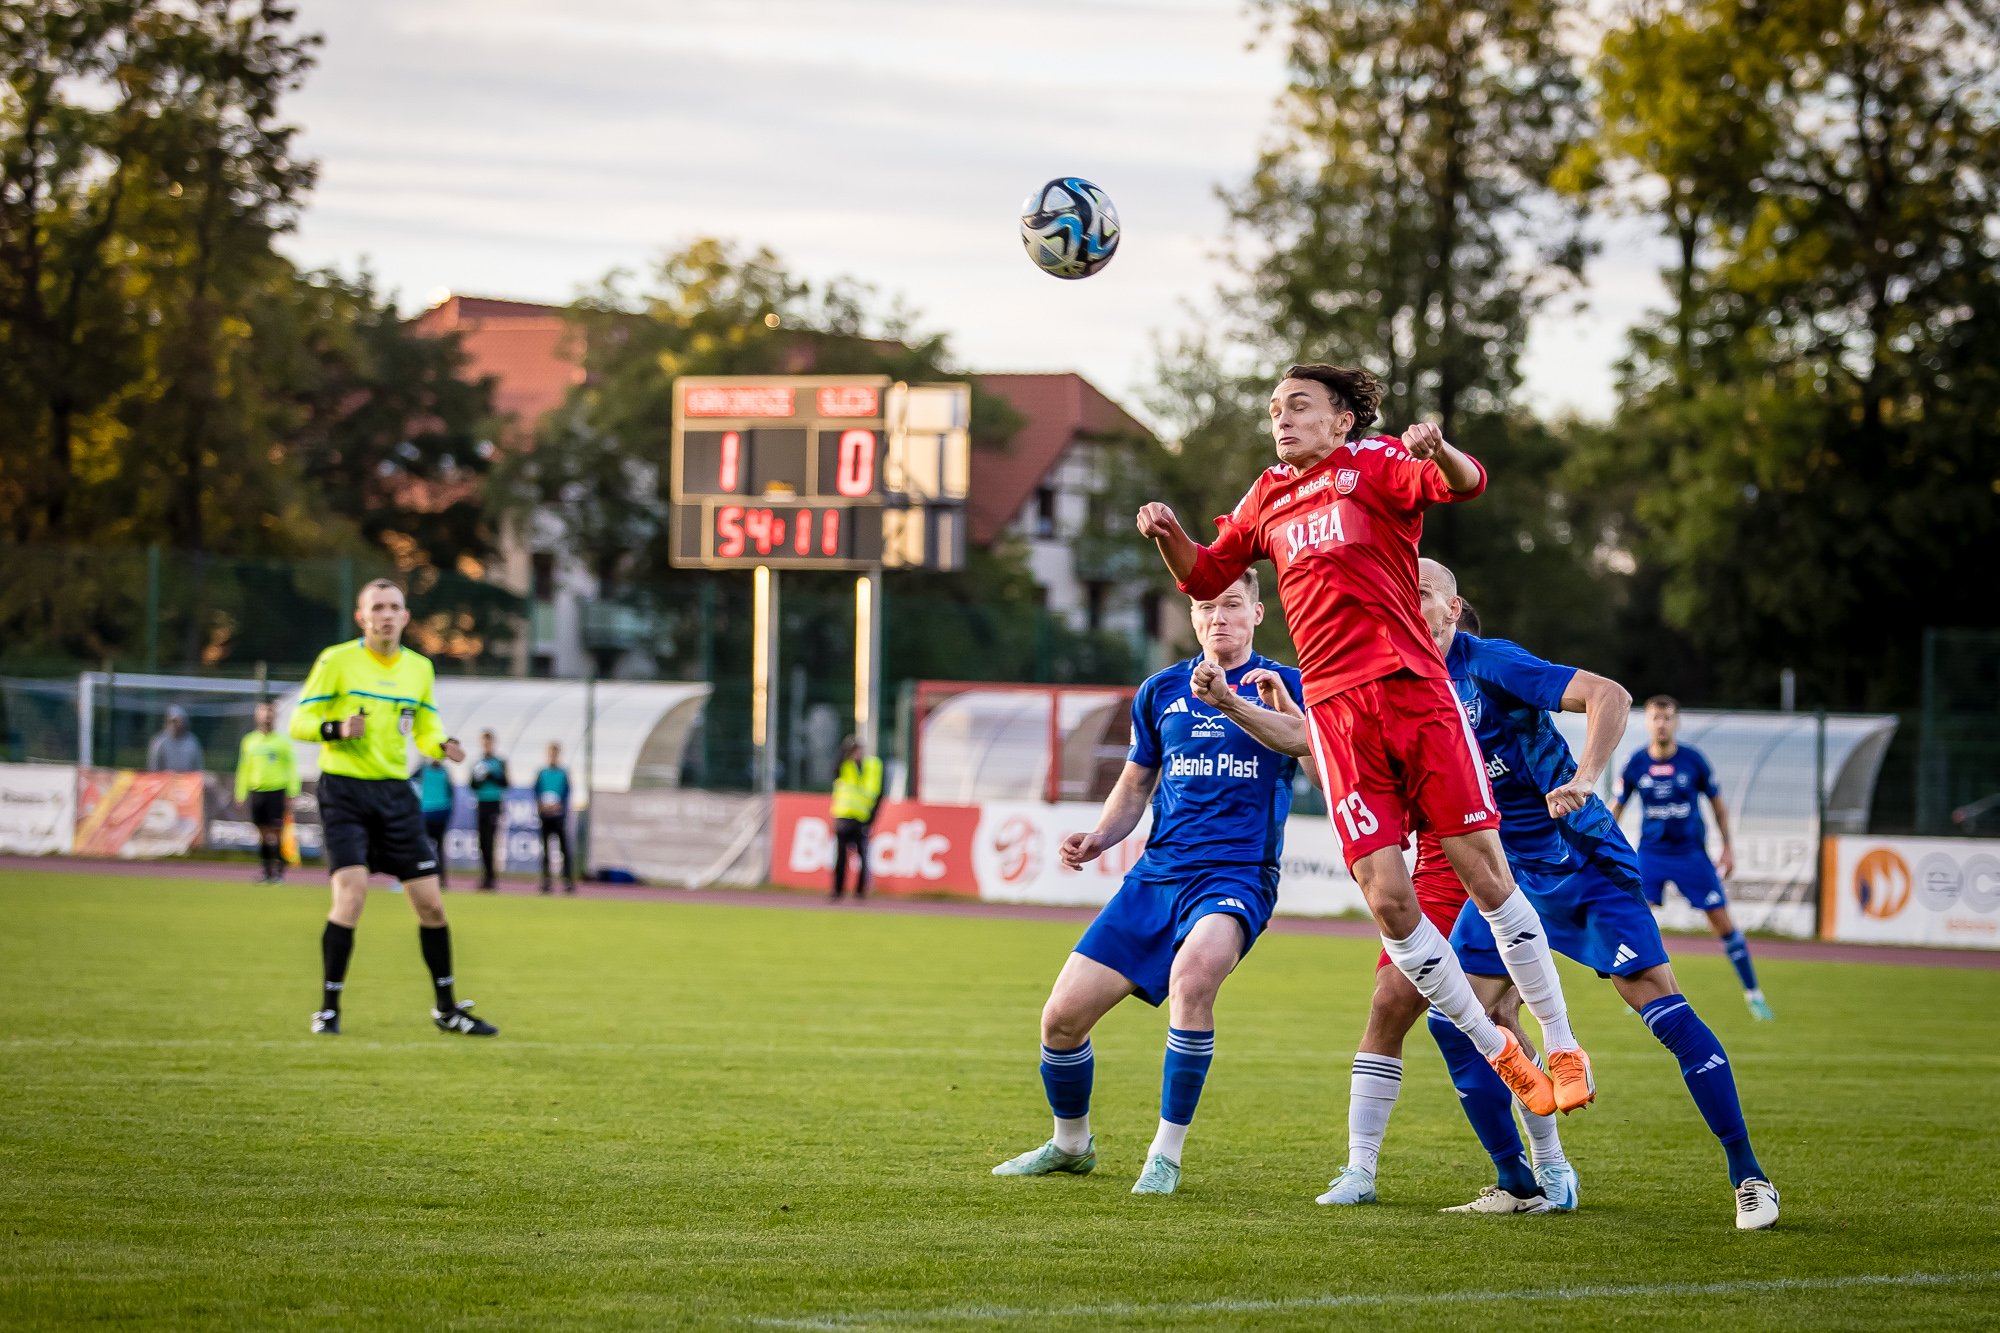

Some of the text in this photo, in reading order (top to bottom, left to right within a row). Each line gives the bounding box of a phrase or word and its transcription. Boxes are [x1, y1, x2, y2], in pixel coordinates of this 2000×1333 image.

[720, 431, 739, 491] 1
[836, 428, 875, 497] 0
[1272, 475, 1330, 511] JAKO Betclic
[1286, 505, 1344, 562] ŚLĘZA
[1169, 753, 1259, 779] Jelenia Plast
[1485, 754, 1510, 779] ast
[1336, 791, 1379, 842] 13
[1463, 810, 1488, 825] JAKO
